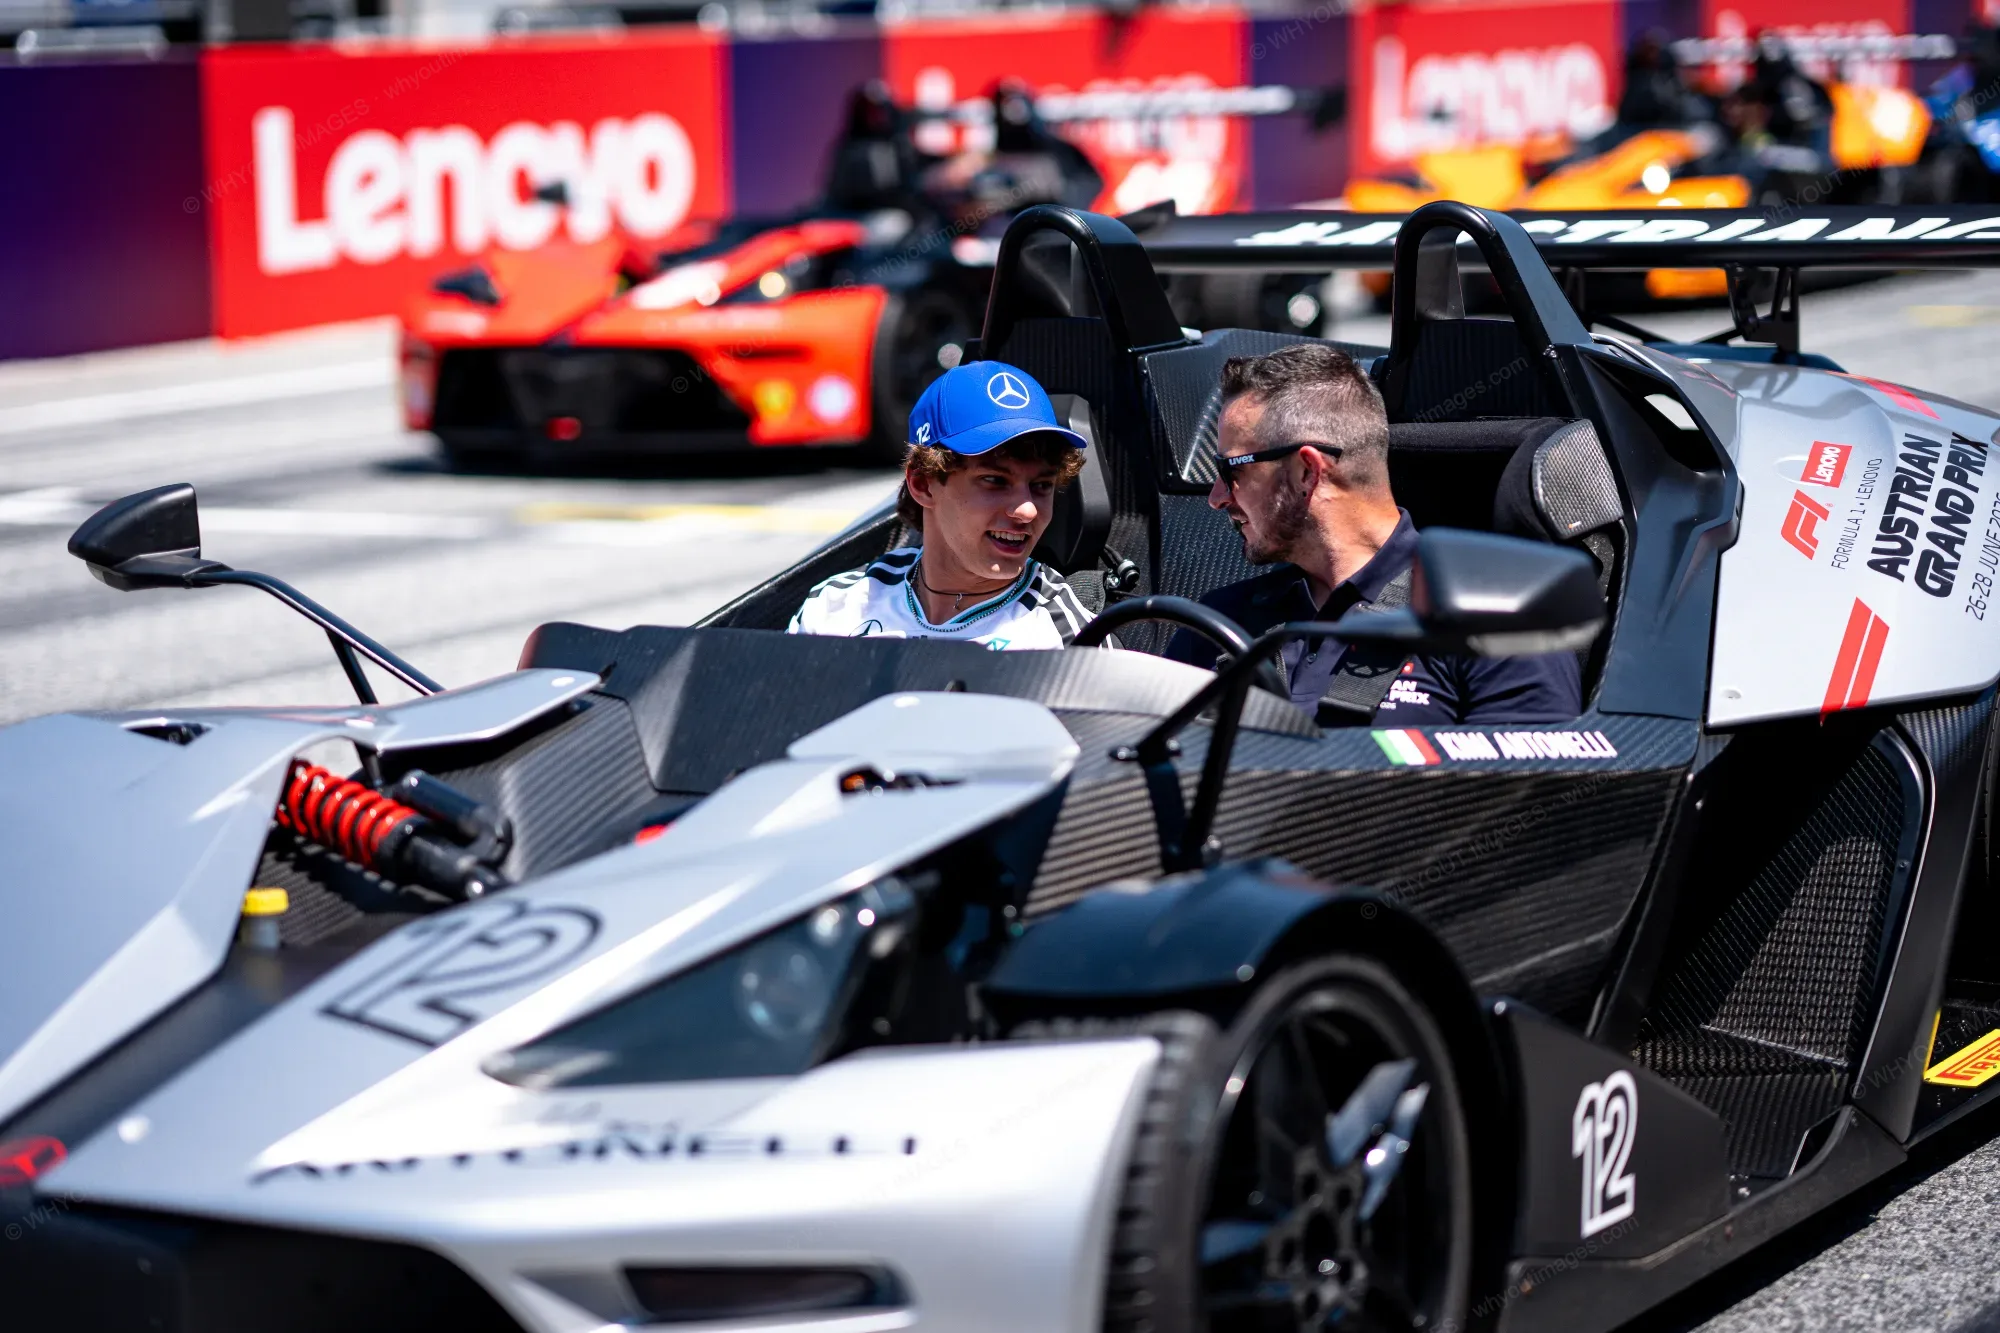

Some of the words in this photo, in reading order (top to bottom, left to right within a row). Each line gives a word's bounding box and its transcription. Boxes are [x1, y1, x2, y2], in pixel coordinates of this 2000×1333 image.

[252, 105, 696, 275] Lenovo
[916, 422, 931, 445] 12
[1228, 454, 1255, 466] uvex
[1808, 446, 1841, 483] Lenovo
[1942, 431, 1989, 494] PRIX
[1780, 488, 1830, 561] F1
[1831, 518, 1862, 570] FORMULA
[1855, 458, 1882, 500] LENOVO
[1866, 432, 1943, 583] AUSTRIAN
[1914, 487, 1975, 598] GRAND
[1965, 572, 1993, 621] 26-28
[1493, 730, 1619, 760] ANTONELLI
[316, 899, 605, 1049] 12
[1572, 1069, 1639, 1239] 12
